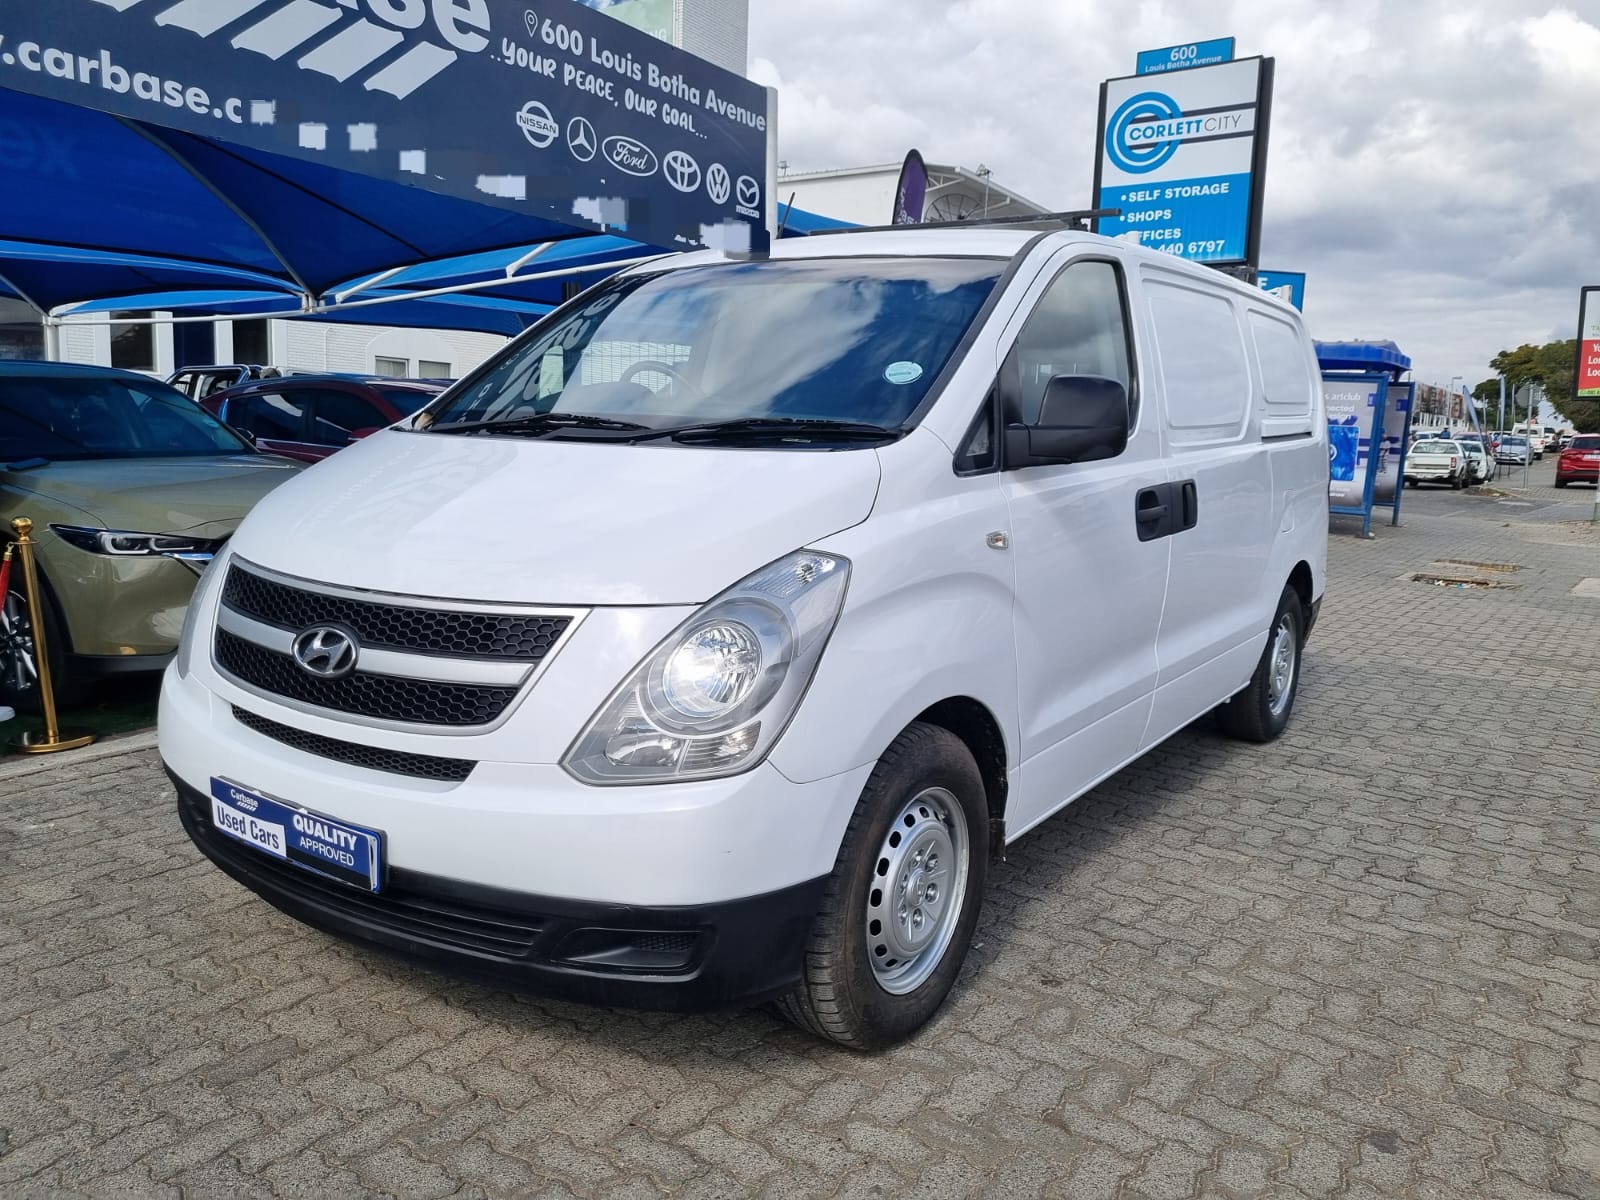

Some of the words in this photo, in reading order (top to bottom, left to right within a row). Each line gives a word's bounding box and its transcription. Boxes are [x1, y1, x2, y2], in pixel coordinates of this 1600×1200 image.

[1169, 45, 1198, 61] 600
[1144, 64, 1165, 73] Louis
[1166, 60, 1190, 70] Botha
[1191, 55, 1222, 66] Avenue
[541, 18, 584, 56] 600
[591, 37, 642, 81] Louis
[647, 62, 700, 106] Botha
[705, 88, 766, 132] Avenue
[563, 62, 619, 108] PEACE,
[624, 87, 658, 118] OUR
[519, 115, 557, 134] NISSAN
[612, 141, 648, 170] Ford
[1128, 189, 1161, 202] SELF
[1165, 182, 1230, 199] STORAGE
[1127, 209, 1172, 223] SHOPS
[1187, 239, 1225, 254] 6797
[230, 788, 259, 808] Carbase
[217, 804, 247, 836] Used
[250, 819, 280, 850] Cars
[292, 814, 357, 852] QUALITY
[299, 836, 355, 867] APPROVED
